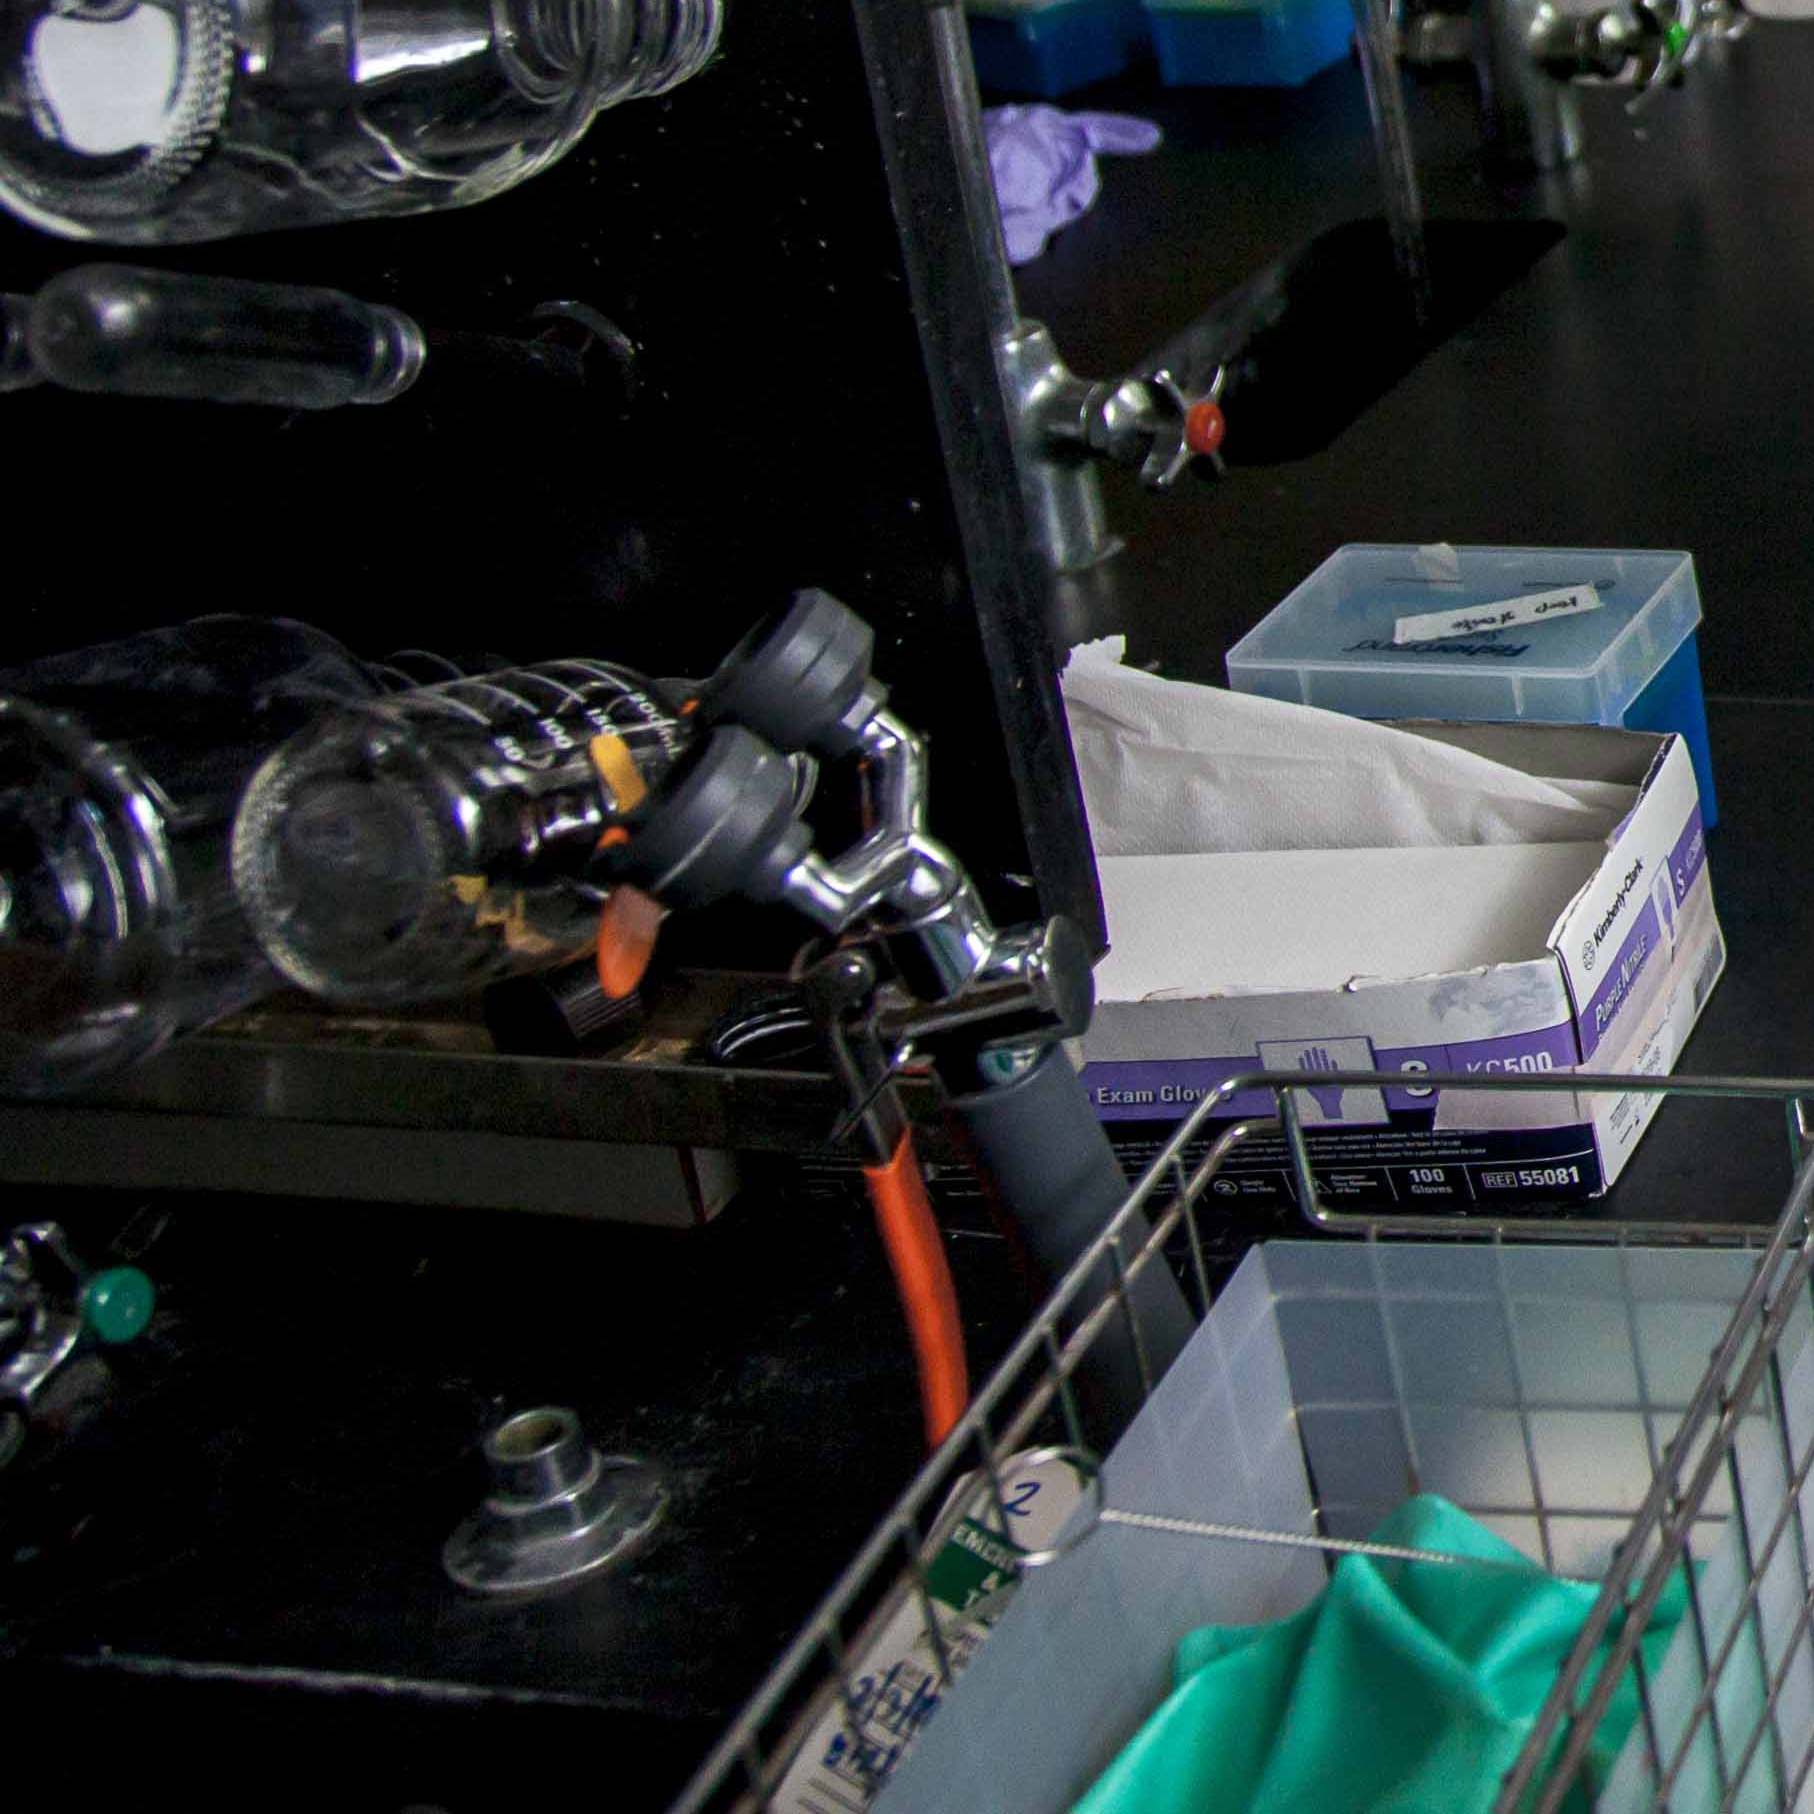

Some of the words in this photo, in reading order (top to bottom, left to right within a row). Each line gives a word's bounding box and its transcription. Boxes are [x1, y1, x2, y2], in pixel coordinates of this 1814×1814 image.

[537, 716, 577, 750] 100
[1593, 856, 1645, 948] Kimberly-Clark
[1096, 1085, 1154, 1105] Exam
[1159, 1084, 1233, 1103] Glovs
[1409, 1168, 1445, 1184] 100
[1485, 1173, 1515, 1187] REF
[1520, 1165, 1581, 1188] 55081
[1003, 1480, 1042, 1517] 2
